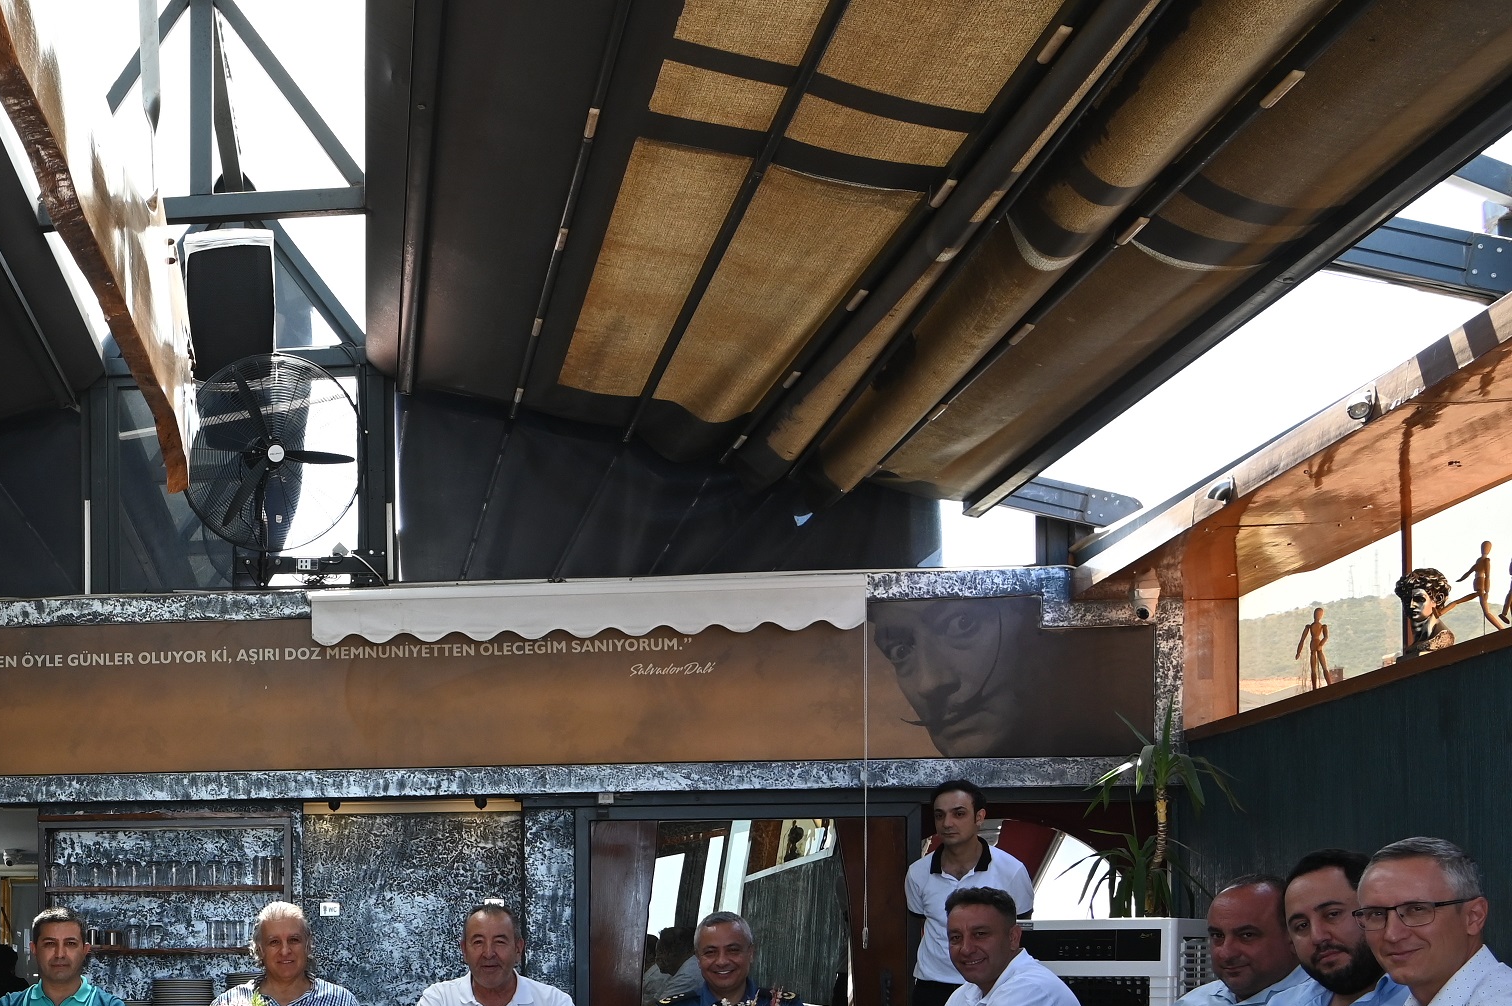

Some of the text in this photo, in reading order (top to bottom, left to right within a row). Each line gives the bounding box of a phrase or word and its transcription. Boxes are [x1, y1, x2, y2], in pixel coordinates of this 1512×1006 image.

[21, 651, 63, 668] ÖYLE
[67, 650, 134, 667] GÜNLER
[138, 649, 207, 665] OLUYOR
[236, 647, 280, 666] AŞIRI
[284, 647, 322, 660] DOZ
[326, 642, 475, 660] MEMNUNİYETTEN
[629, 663, 683, 677] Salvador
